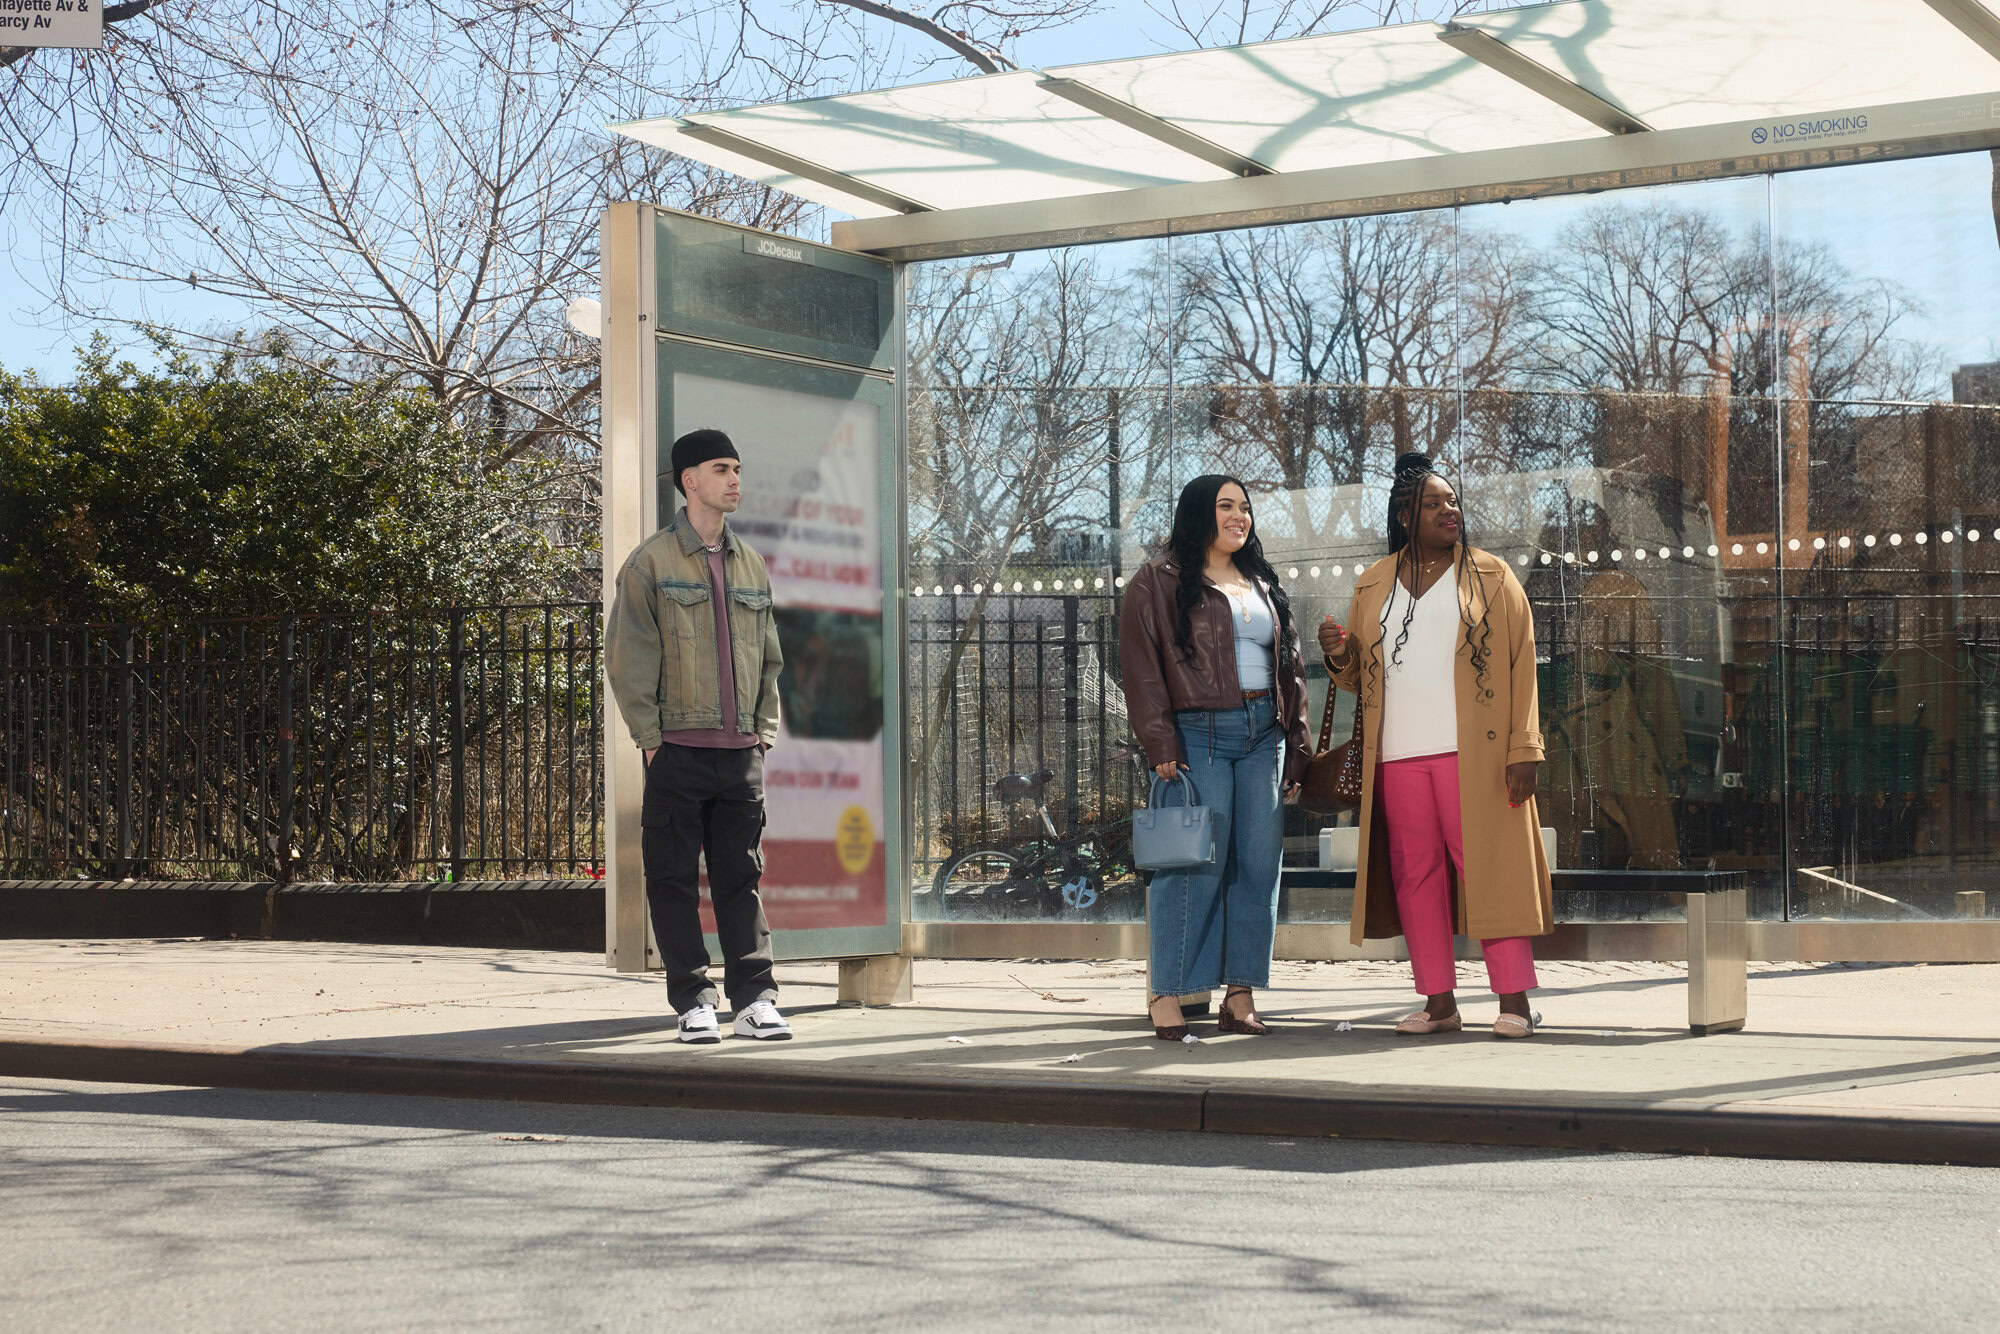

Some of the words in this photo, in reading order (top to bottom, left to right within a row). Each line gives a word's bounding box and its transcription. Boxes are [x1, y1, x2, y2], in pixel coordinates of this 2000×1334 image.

[0, 0, 52, 13] fayette
[56, 0, 73, 12] Av
[77, 0, 89, 12] &
[33, 14, 52, 28] Av
[1773, 123, 1795, 138] NO
[1798, 115, 1868, 135] SMOKING
[757, 239, 802, 261] JCDecaux
